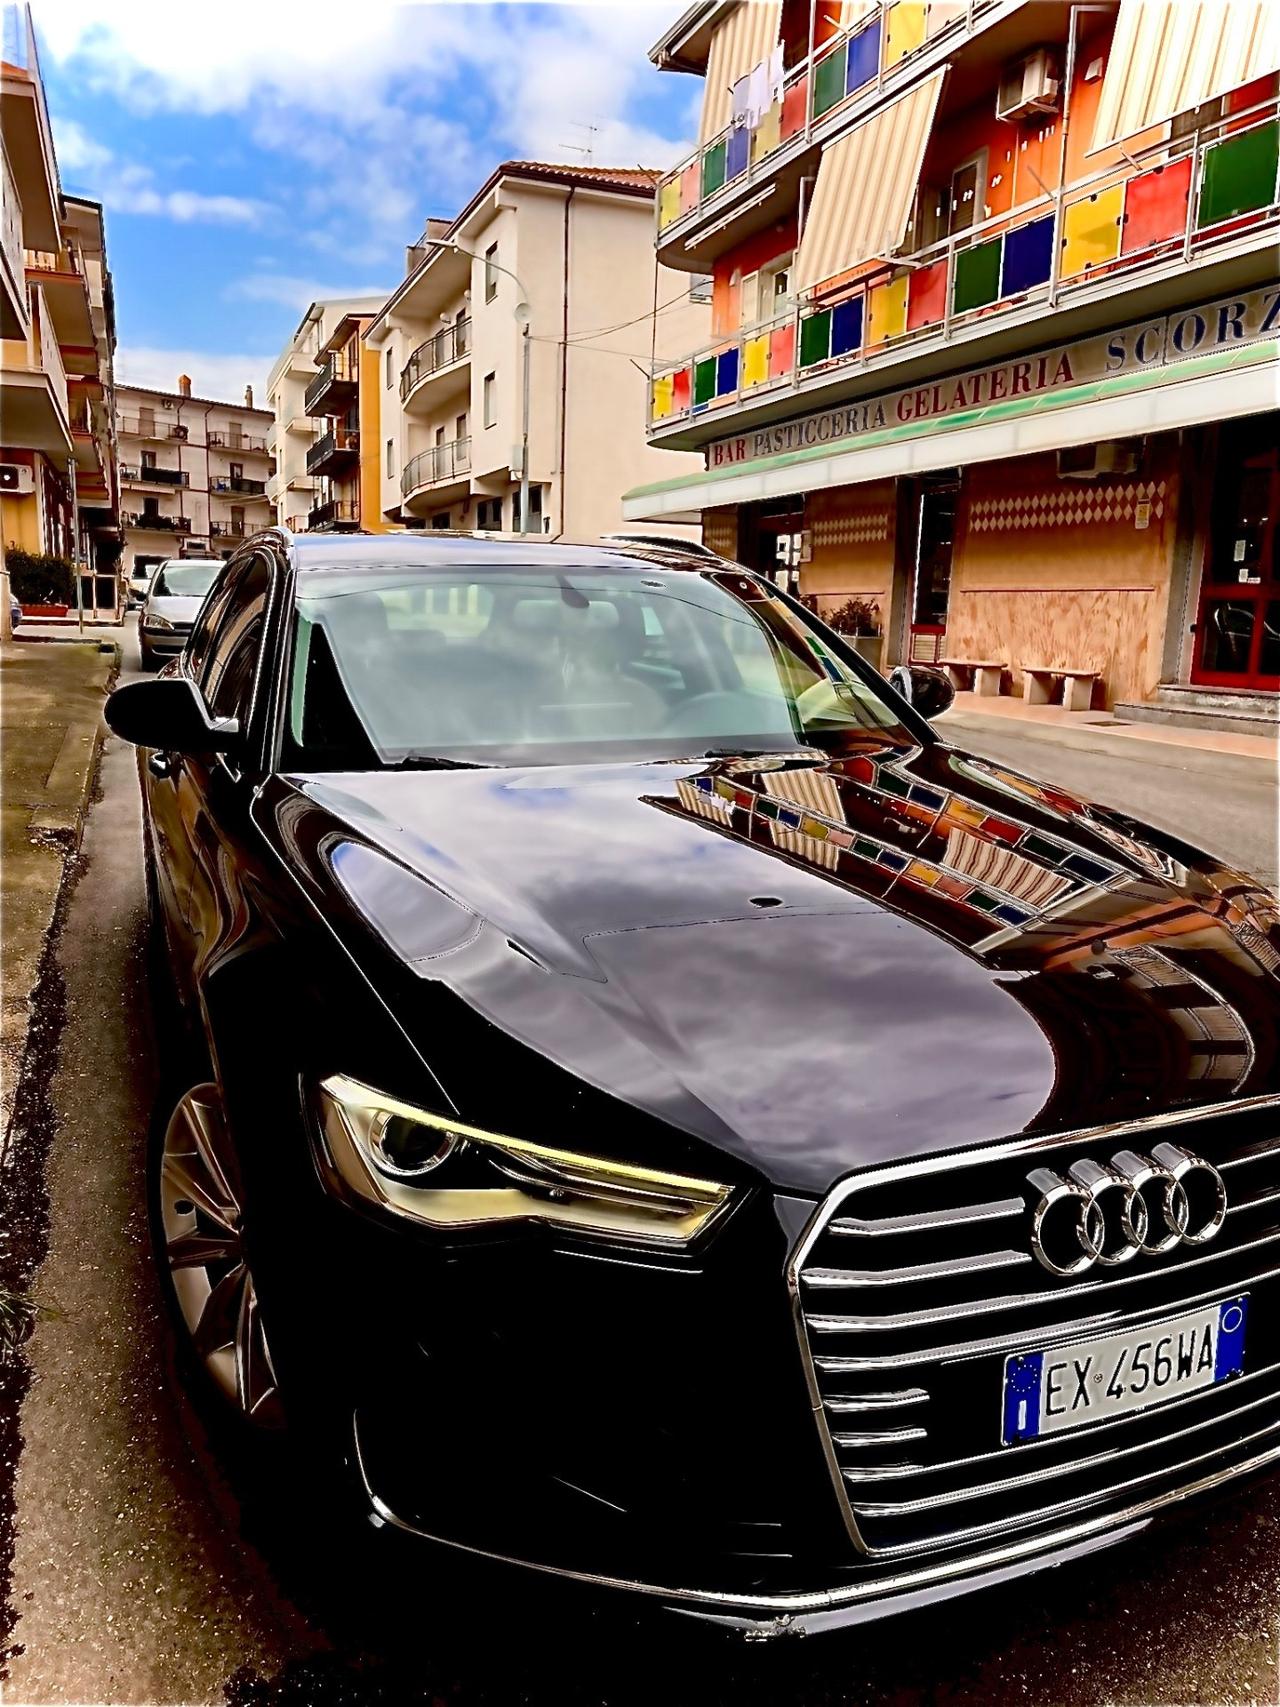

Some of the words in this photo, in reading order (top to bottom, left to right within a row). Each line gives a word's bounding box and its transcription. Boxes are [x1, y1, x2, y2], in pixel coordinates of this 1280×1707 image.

[714, 438, 746, 466] BAR
[753, 400, 887, 457] PASTICCERIA
[896, 351, 1074, 421] GELATERIA
[1046, 1357, 1093, 1417] EX
